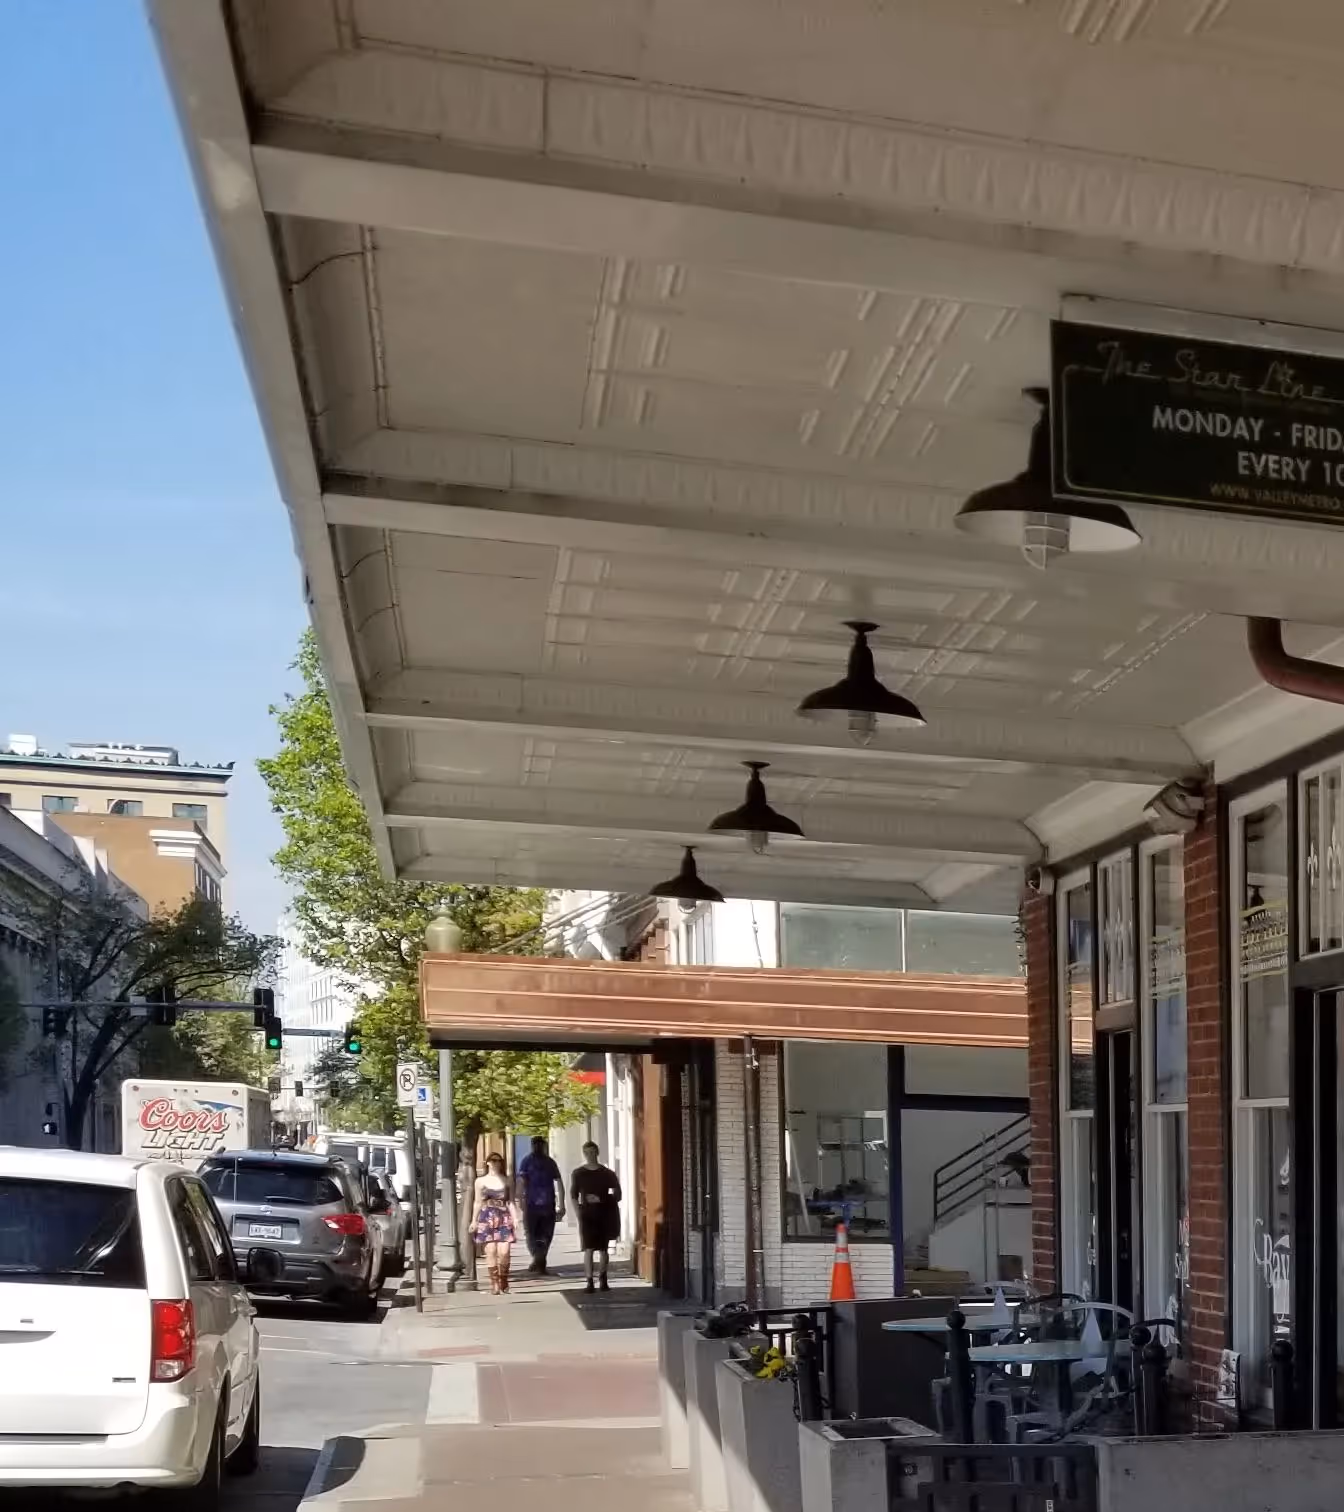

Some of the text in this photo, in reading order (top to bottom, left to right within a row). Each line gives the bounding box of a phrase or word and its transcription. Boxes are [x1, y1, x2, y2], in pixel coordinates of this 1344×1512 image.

[1097, 341, 1154, 388] The
[1176, 348, 1243, 386] Star
[1152, 405, 1264, 442] MONDAY
[1237, 450, 1311, 483] EVERY
[139, 1097, 230, 1133] Coors
[141, 1129, 225, 1150] LIGHT
